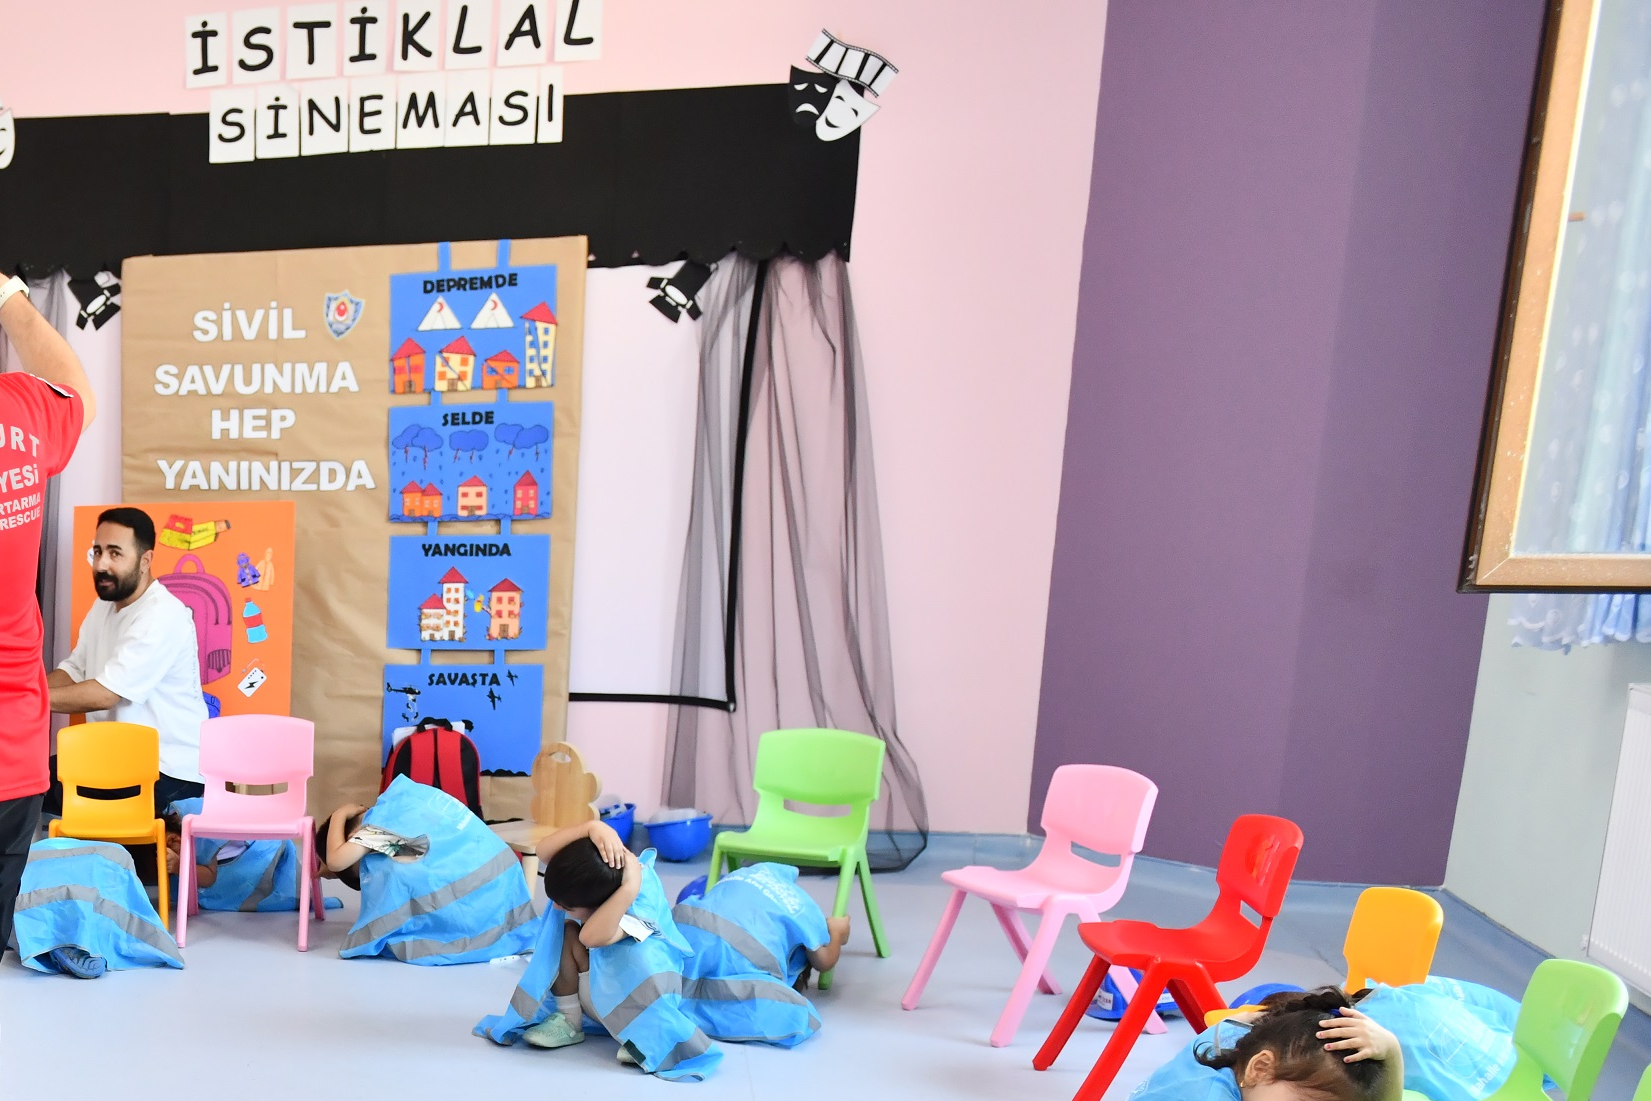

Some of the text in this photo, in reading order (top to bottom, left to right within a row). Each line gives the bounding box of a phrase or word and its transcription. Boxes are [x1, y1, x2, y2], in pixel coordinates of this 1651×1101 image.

[191, 0, 594, 75] İSTİKLAL
[217, 83, 554, 143] SİNEMASI
[422, 272, 518, 294] DEPREMDE
[192, 300, 306, 342] SİVİL
[153, 361, 359, 395] SAVUNMA
[211, 408, 296, 439] HEP
[441, 410, 494, 427] SELDE
[156, 459, 376, 491] YANINIZDA
[421, 543, 511, 557] YANGINDA
